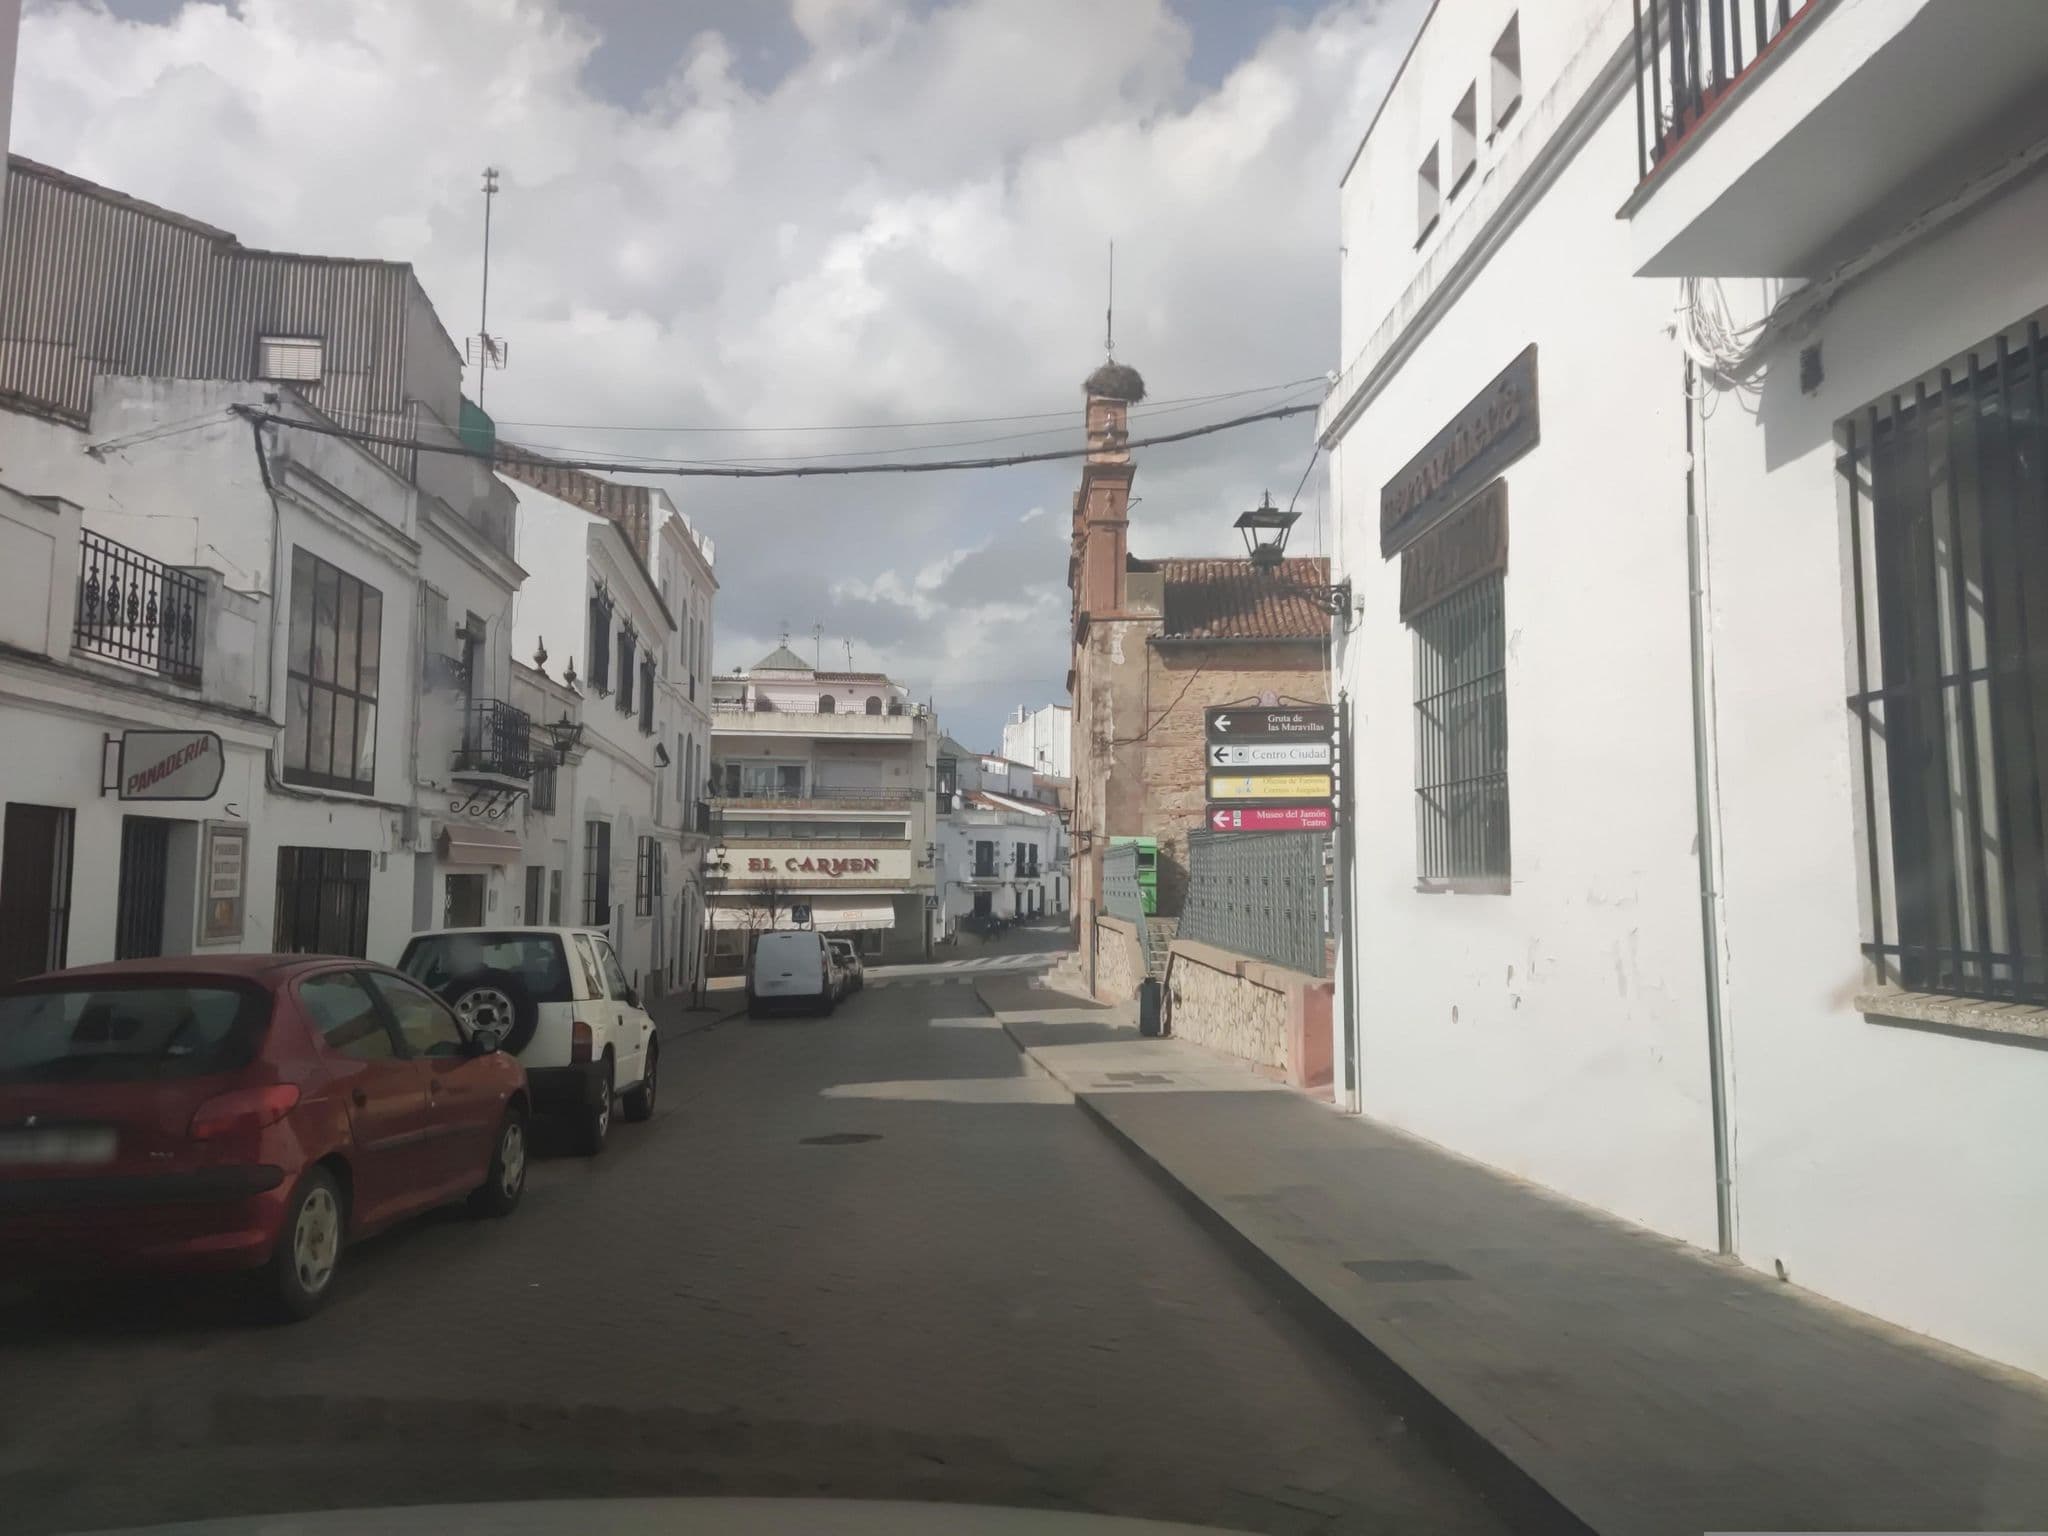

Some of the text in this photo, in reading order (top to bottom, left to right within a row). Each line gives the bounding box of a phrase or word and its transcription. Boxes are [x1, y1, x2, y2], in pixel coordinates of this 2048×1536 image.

[1267, 714, 1303, 723] Gruta de
[1268, 723, 1325, 731] las Maravillas
[1252, 747, 1327, 760] Centro Ciudad
[127, 736, 209, 795] PANADERIA
[1256, 809, 1326, 819] Museo del Jamón
[1302, 818, 1327, 827] Teatro
[747, 856, 881, 877] EL CARMEN
